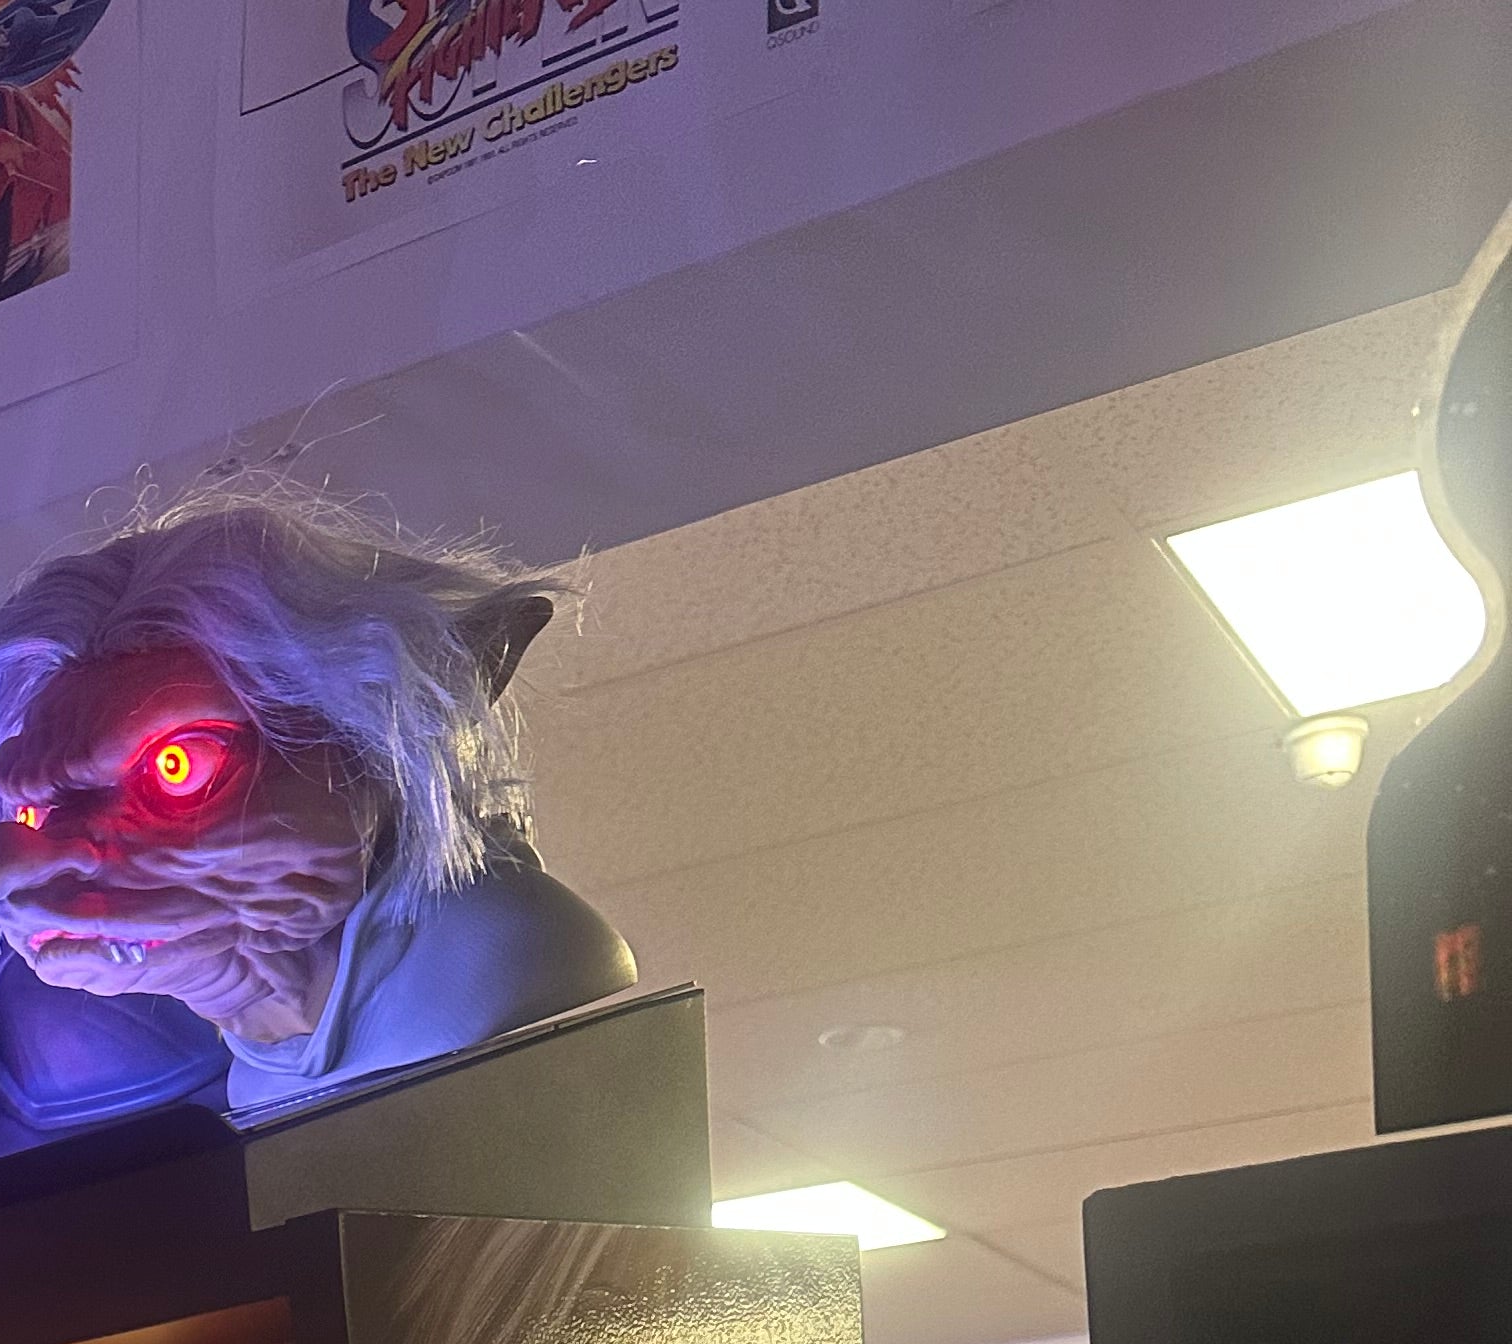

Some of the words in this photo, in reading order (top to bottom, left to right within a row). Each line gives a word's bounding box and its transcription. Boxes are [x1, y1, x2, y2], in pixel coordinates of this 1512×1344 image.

[342, 163, 397, 203] The
[402, 127, 475, 177] New
[482, 44, 679, 142] Challengers
